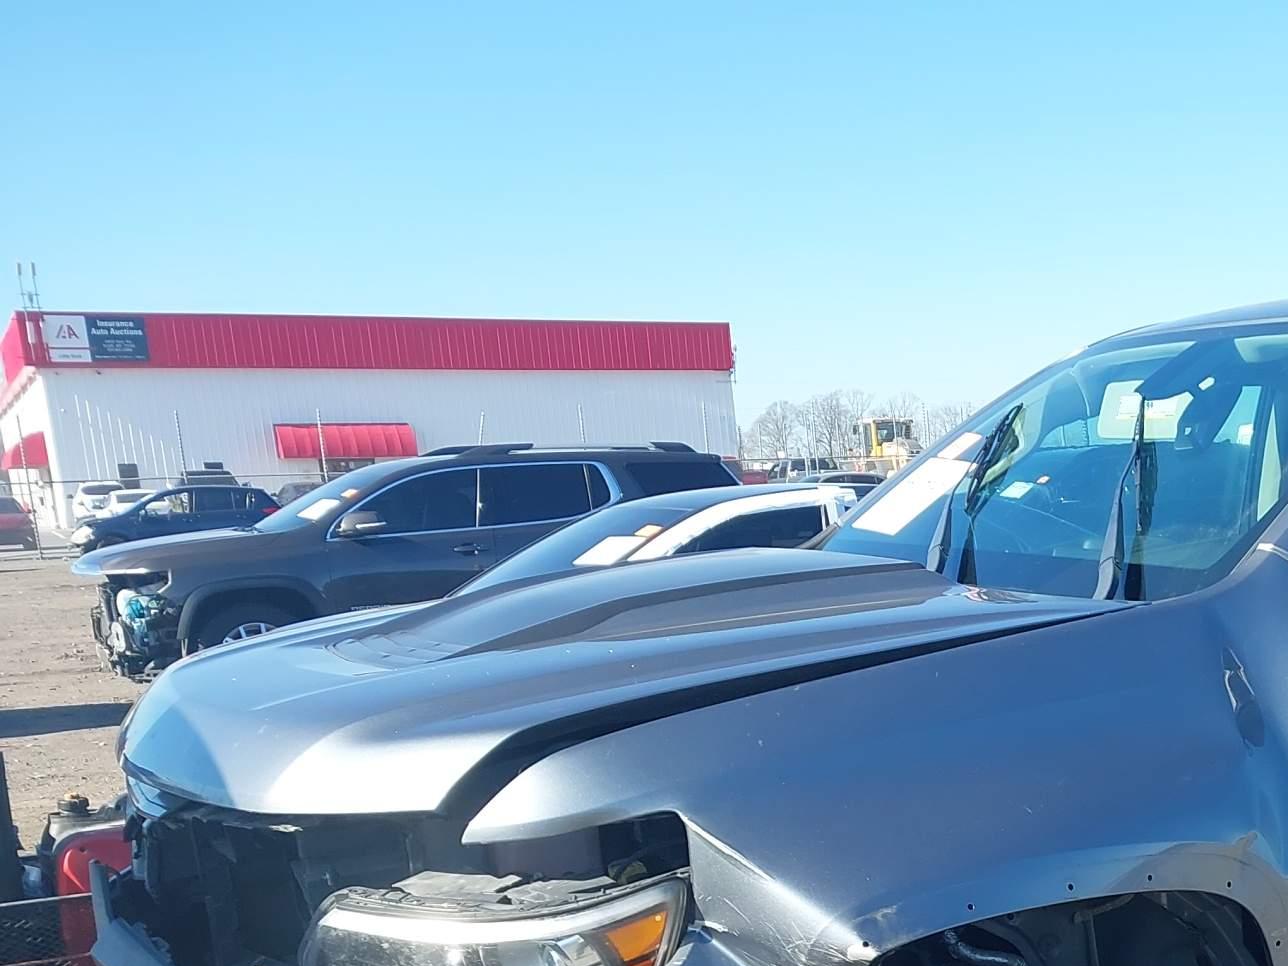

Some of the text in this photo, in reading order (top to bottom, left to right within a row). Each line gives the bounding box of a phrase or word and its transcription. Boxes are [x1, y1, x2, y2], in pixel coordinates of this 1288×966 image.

[96, 319, 134, 327] Insurance
[90, 327, 143, 335] Auto Auctions
